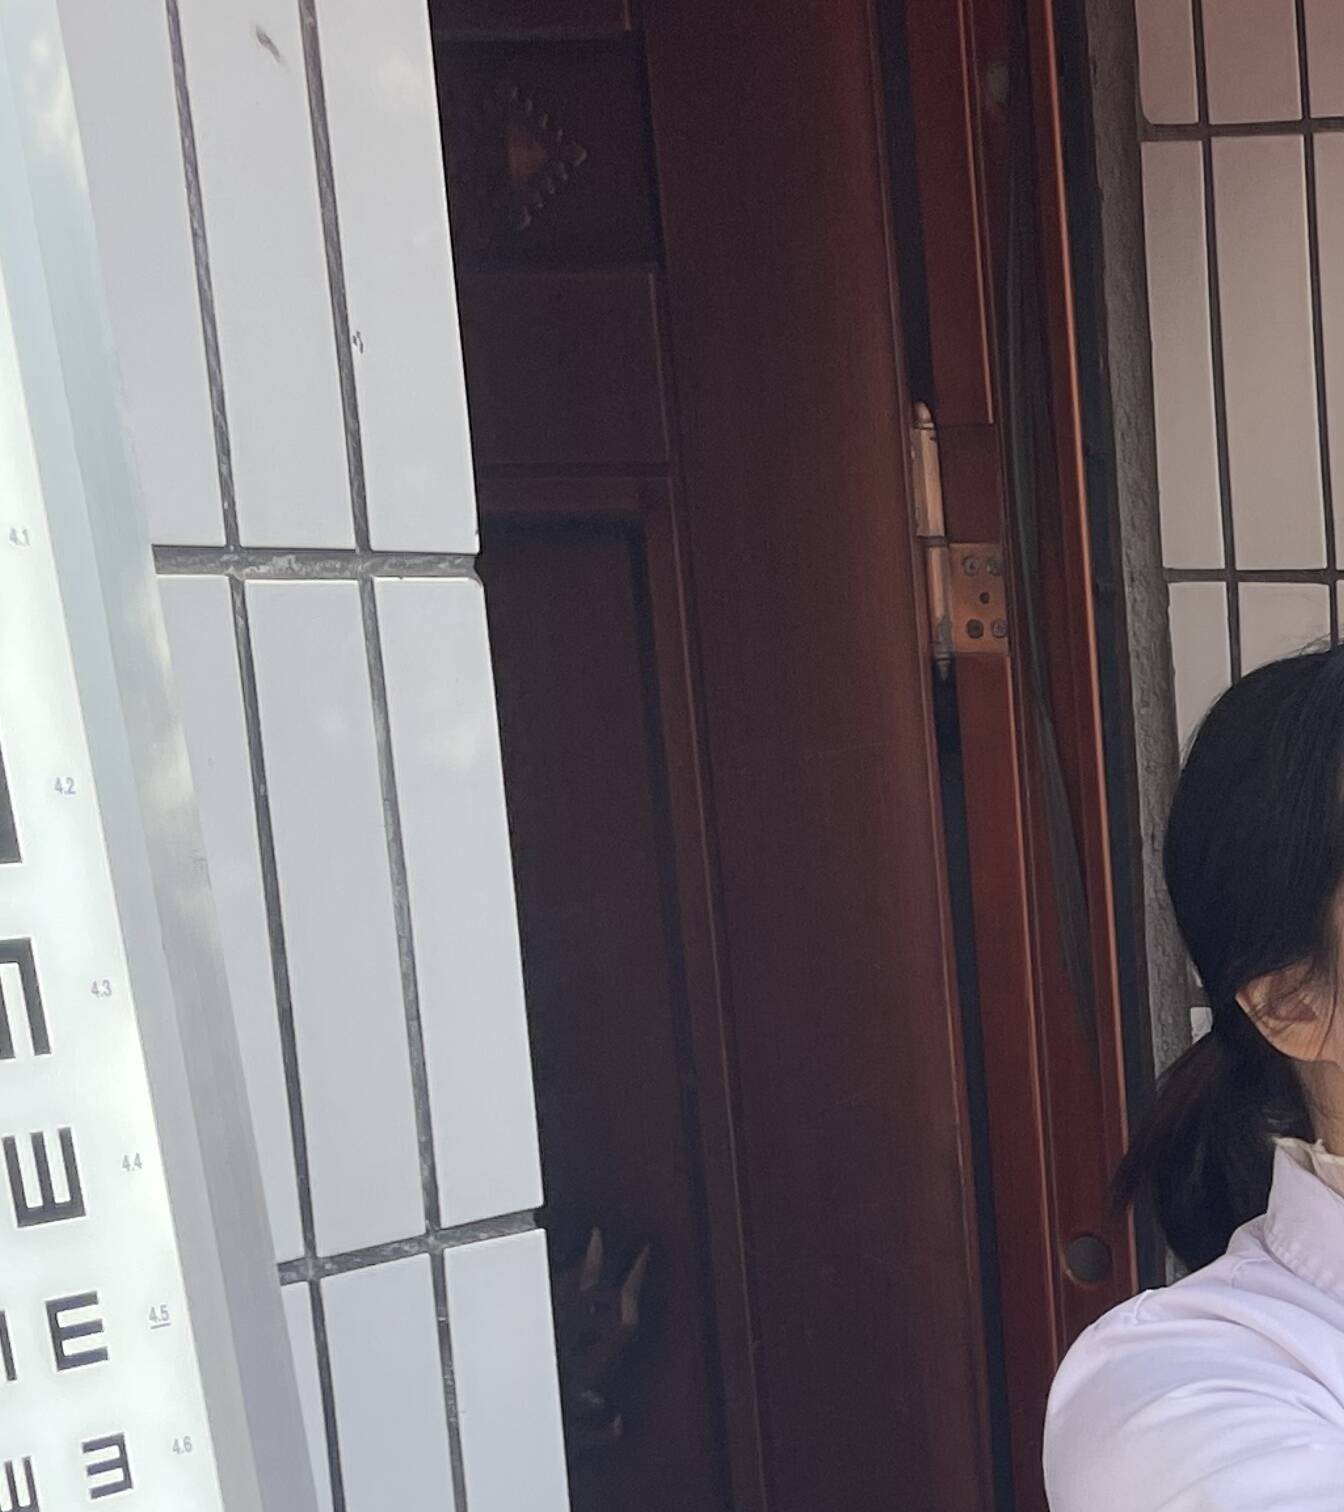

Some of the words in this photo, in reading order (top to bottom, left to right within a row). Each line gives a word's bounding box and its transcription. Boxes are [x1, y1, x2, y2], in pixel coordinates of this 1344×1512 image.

[54, 776, 77, 796] 4.2
[91, 979, 113, 999] 4.3
[122, 1152, 143, 1173] 4.4
[149, 1303, 172, 1326] 4.5
[171, 1435, 193, 1456] 4.6
